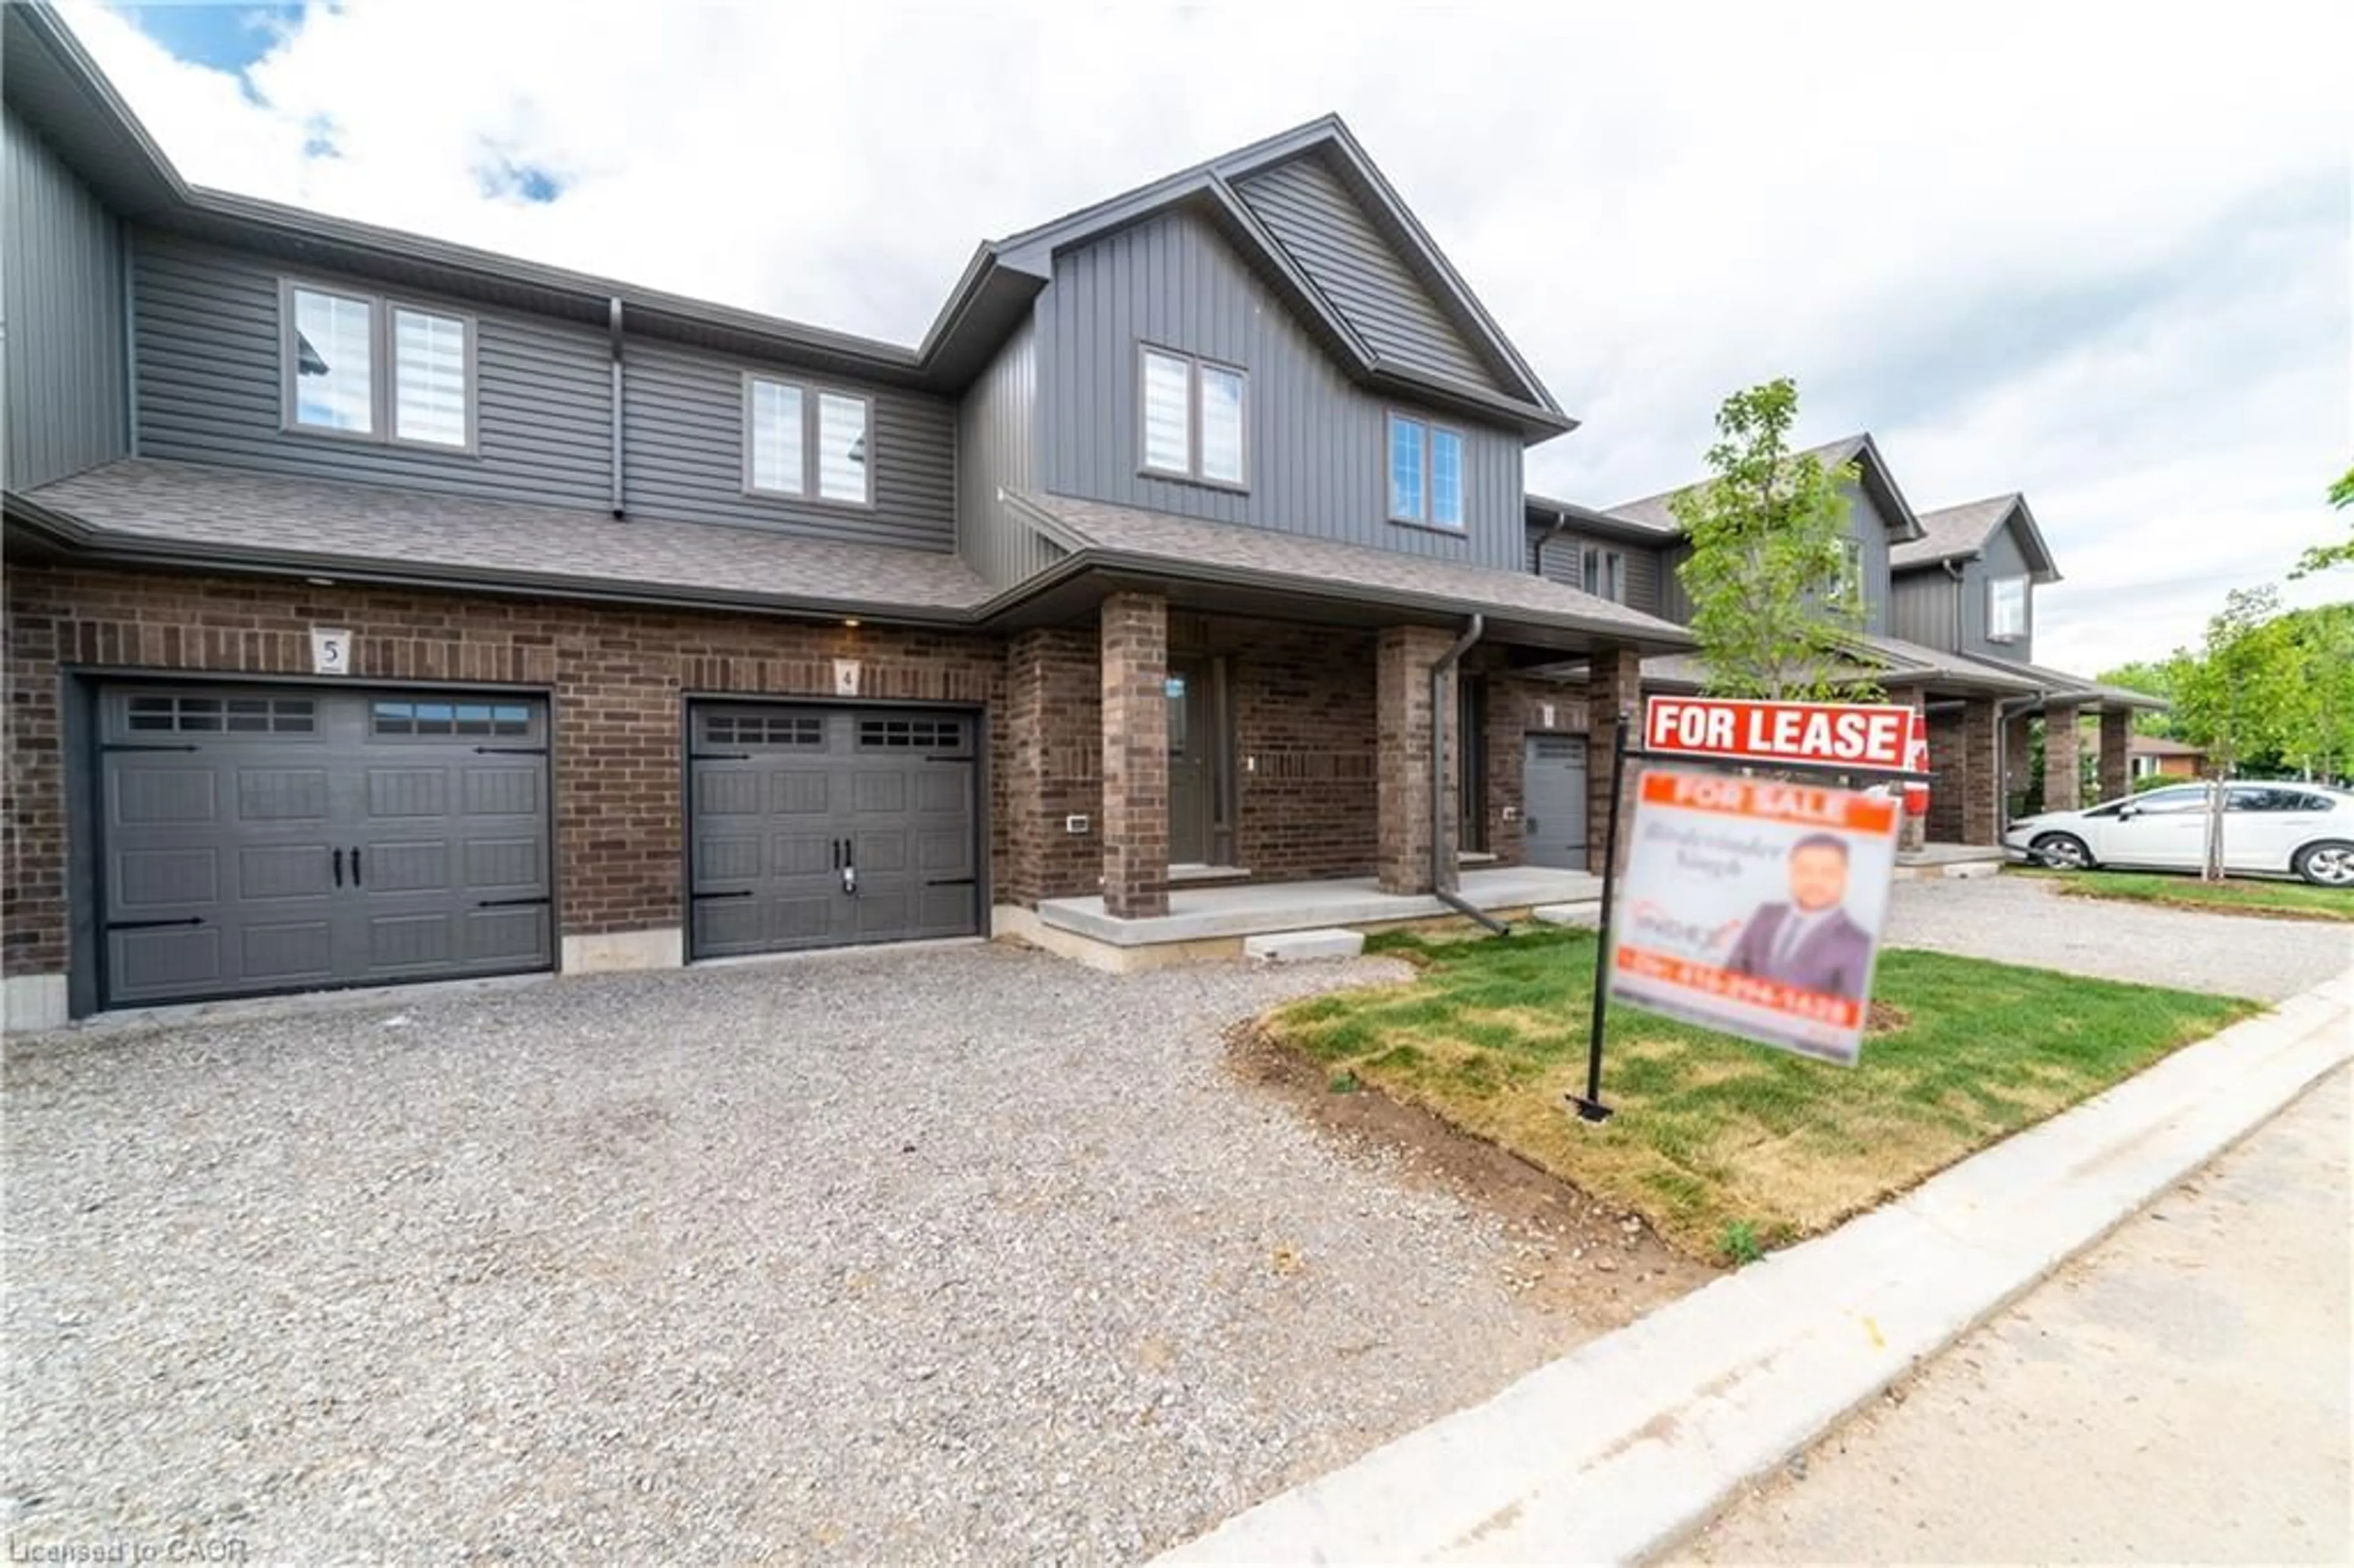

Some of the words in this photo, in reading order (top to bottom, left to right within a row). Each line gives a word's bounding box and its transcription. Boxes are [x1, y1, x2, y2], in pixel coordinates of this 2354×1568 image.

[324, 640, 339, 663] 5
[843, 670, 852, 685] 4
[1655, 706, 1735, 750] FOR
[1747, 709, 1899, 761] LEASE
[1677, 774, 1741, 812] FOR
[1756, 781, 1847, 824] SALE
